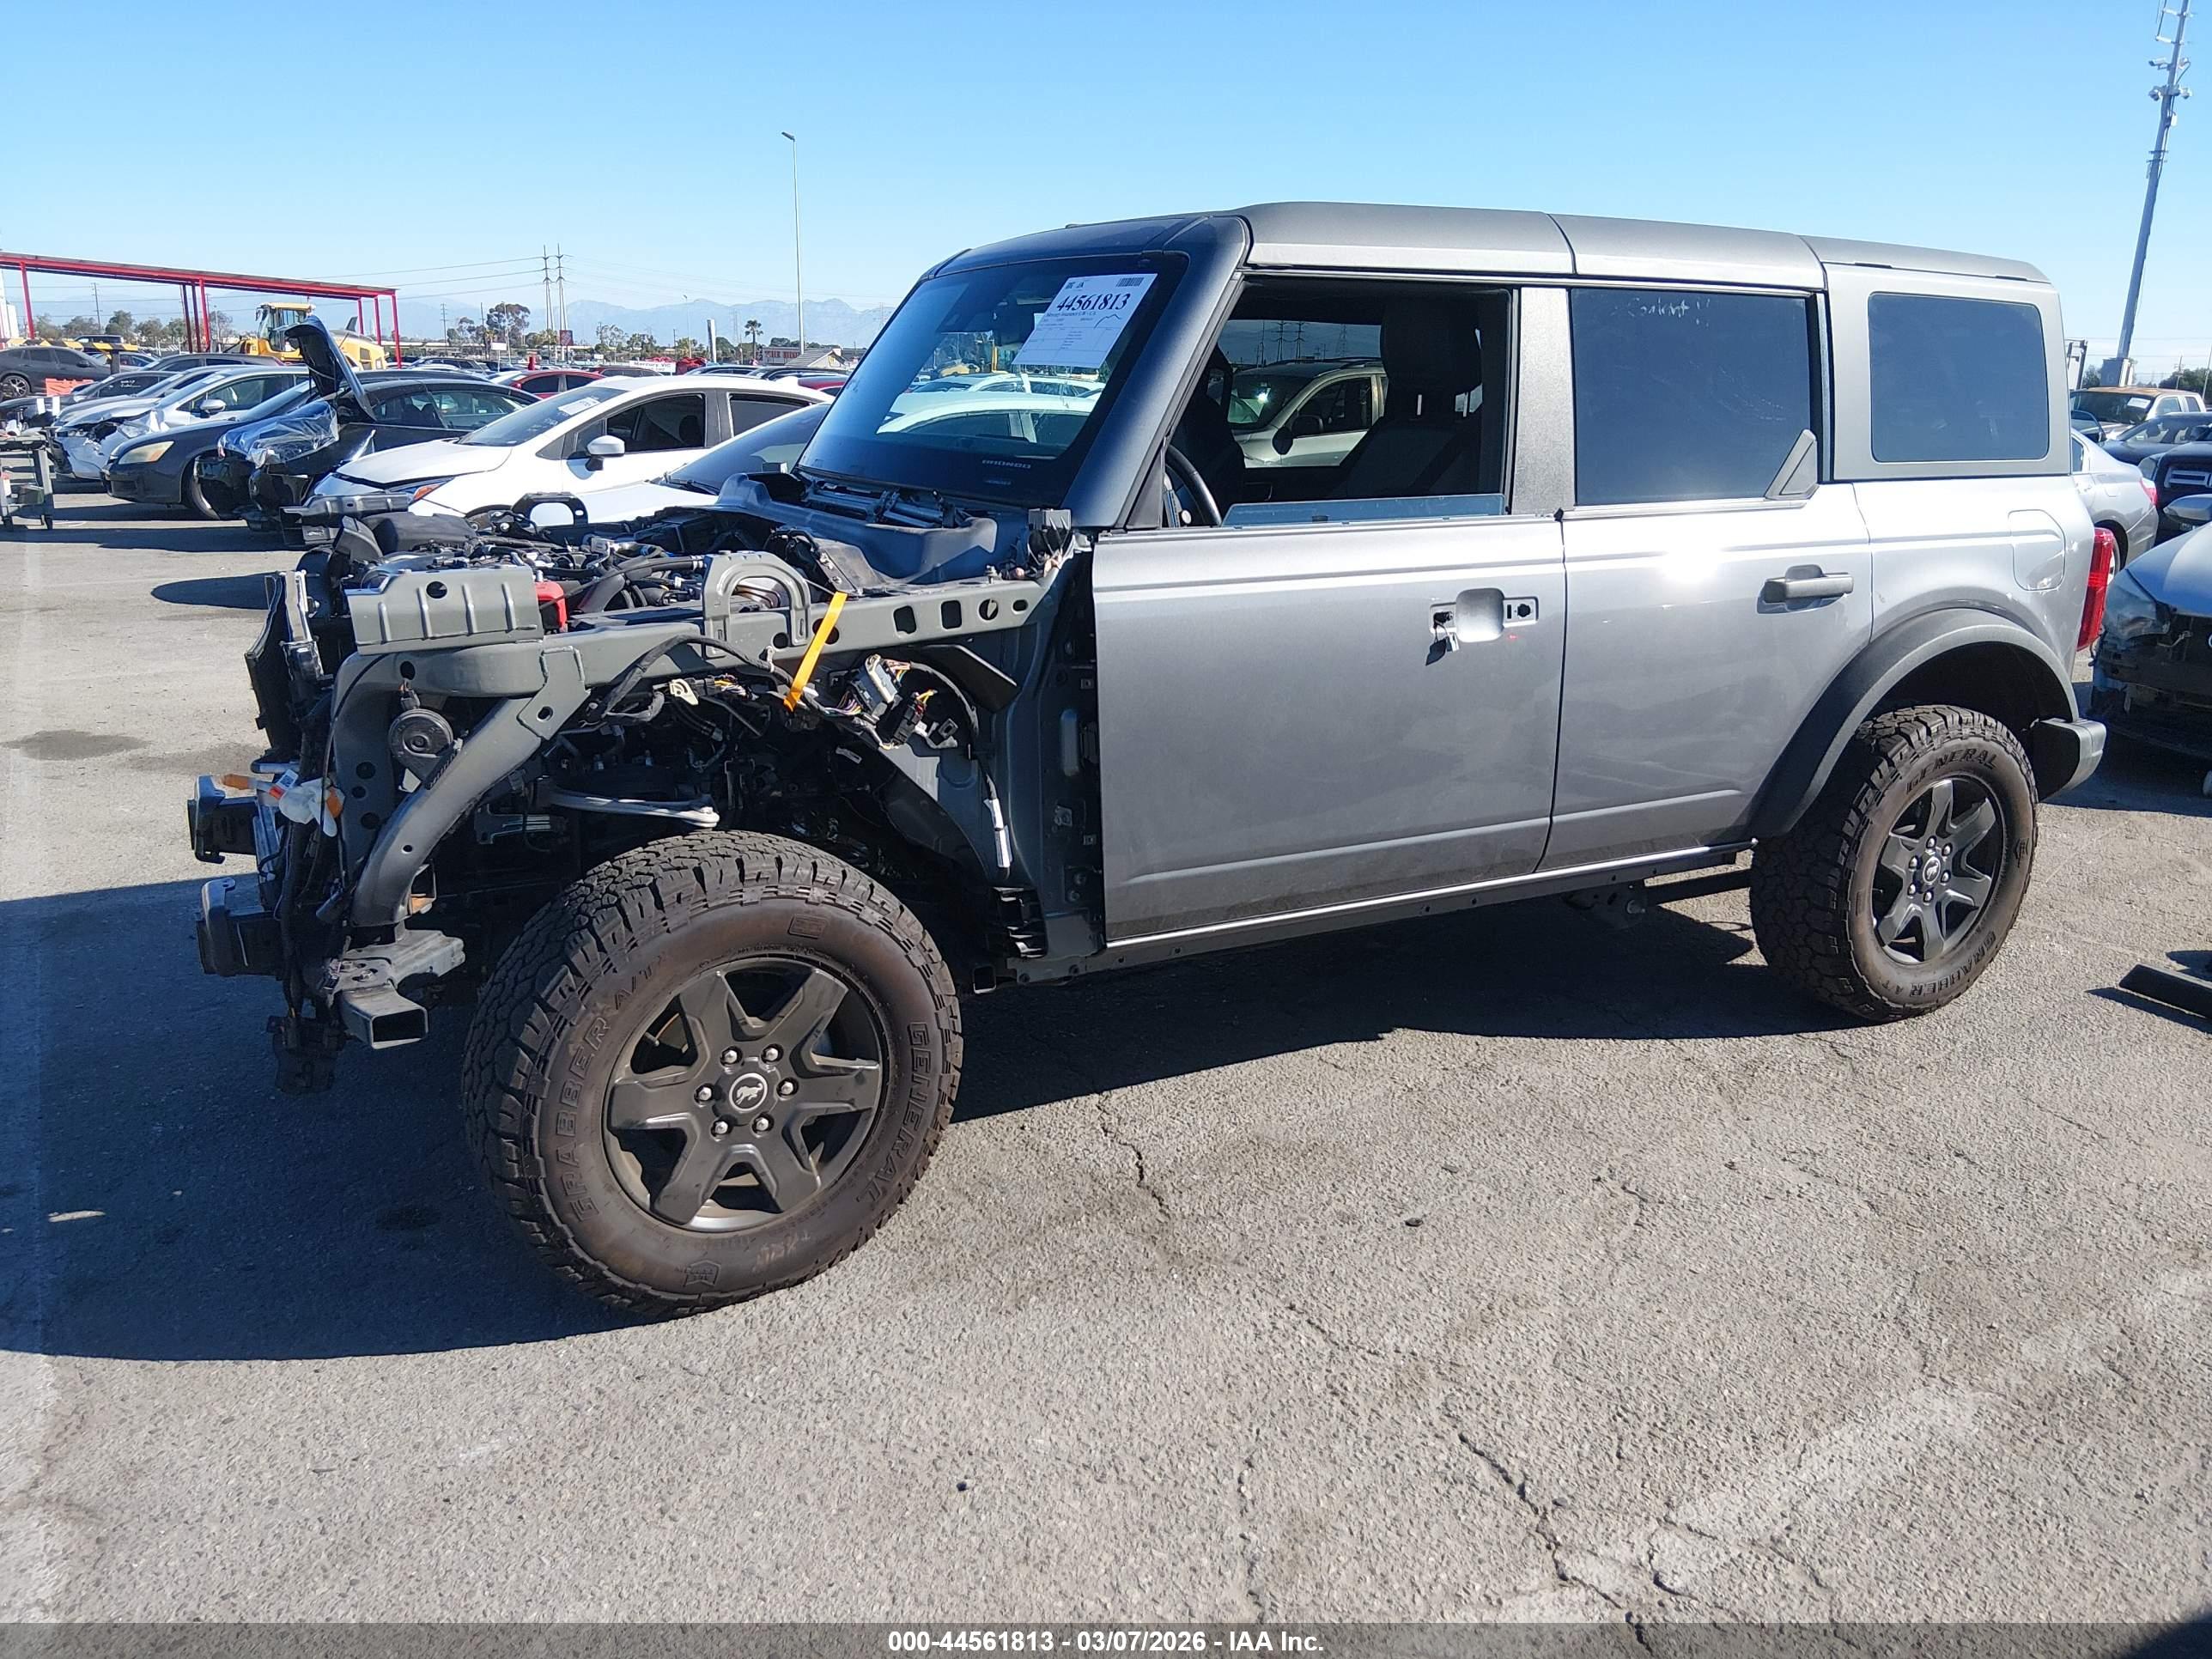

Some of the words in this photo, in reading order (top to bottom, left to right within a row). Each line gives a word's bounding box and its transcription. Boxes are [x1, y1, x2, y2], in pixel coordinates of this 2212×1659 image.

[1056, 293, 1131, 312] 44561813
[556, 1016, 611, 1224] GRABBER
[857, 1021, 932, 1203] GENERAL
